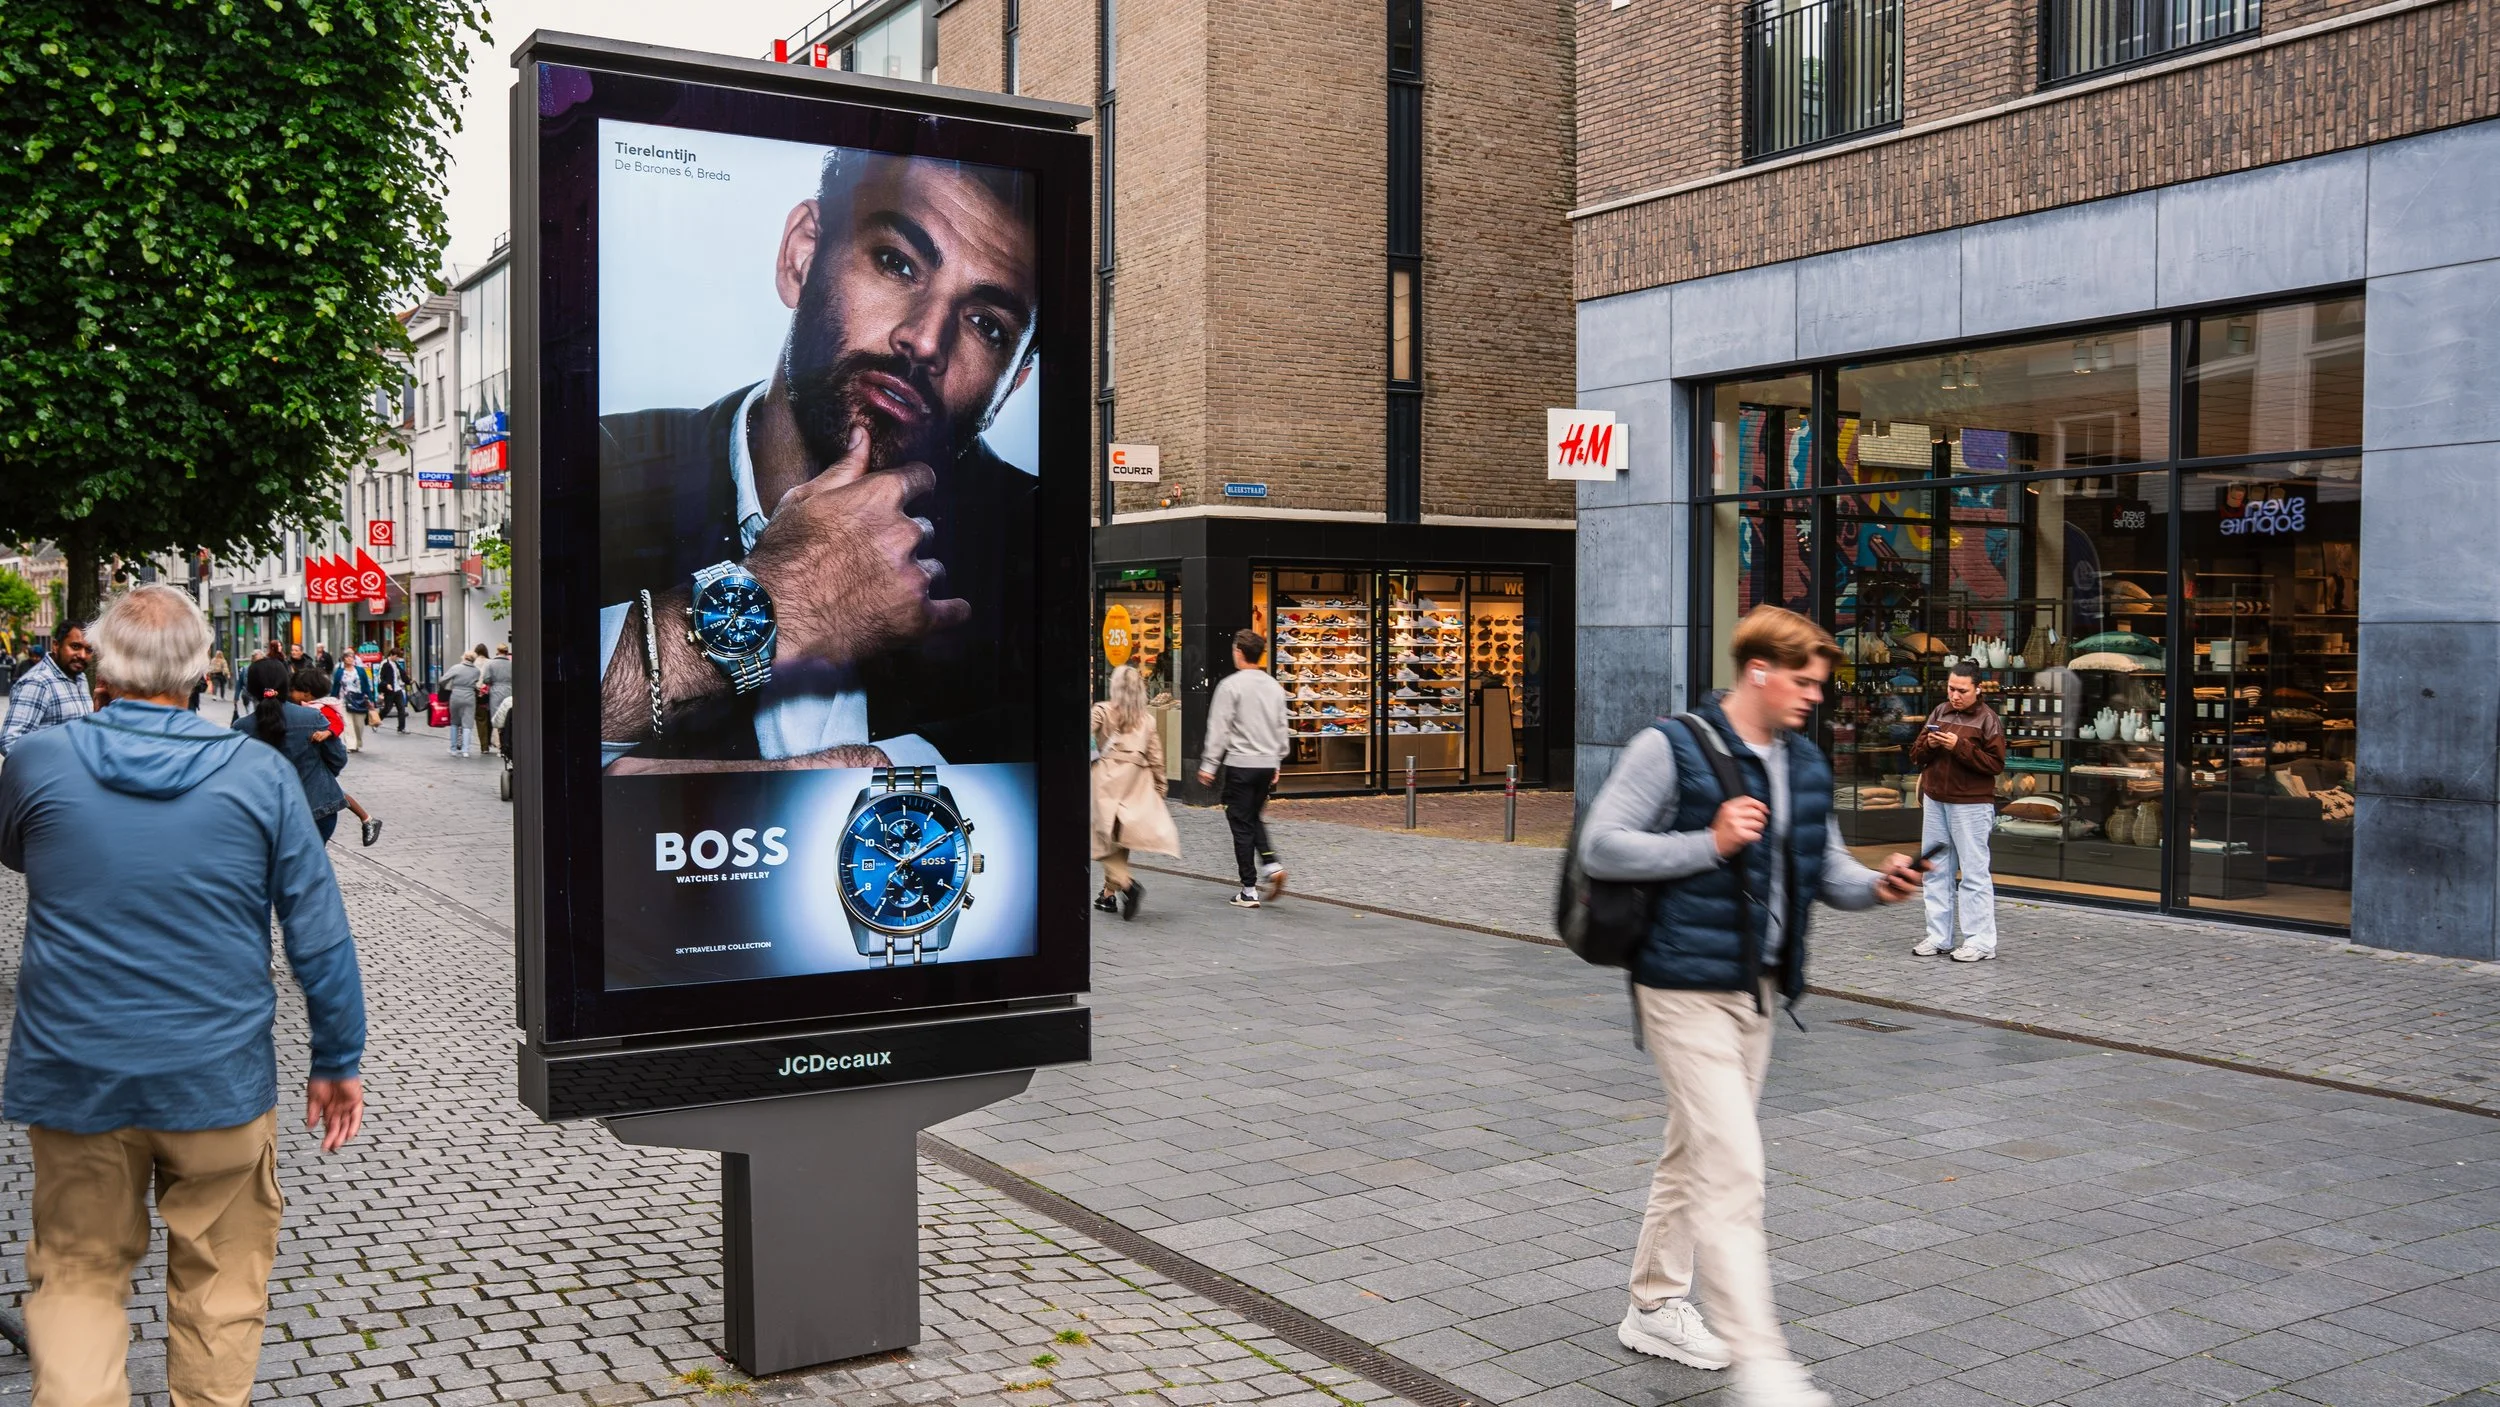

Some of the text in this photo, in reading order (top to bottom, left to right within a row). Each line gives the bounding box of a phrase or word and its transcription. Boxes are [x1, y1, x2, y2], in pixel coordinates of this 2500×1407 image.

[615, 141, 697, 164] Tierelantijn
[615, 159, 731, 182] De Barones 6, Breda
[1558, 424, 1613, 467] H&M
[1113, 466, 1153, 475] COURIR
[250, 598, 271, 613] JD
[1105, 628, 1129, 647] -25%
[655, 827, 790, 871] BOSS
[865, 838, 874, 847] 10
[921, 857, 946, 866] BOSS
[676, 871, 770, 884] WATCHES & JEWELRY
[675, 941, 772, 955] SKYTRAVELLER COLLECTION
[778, 1051, 892, 1076] JCDecaux
